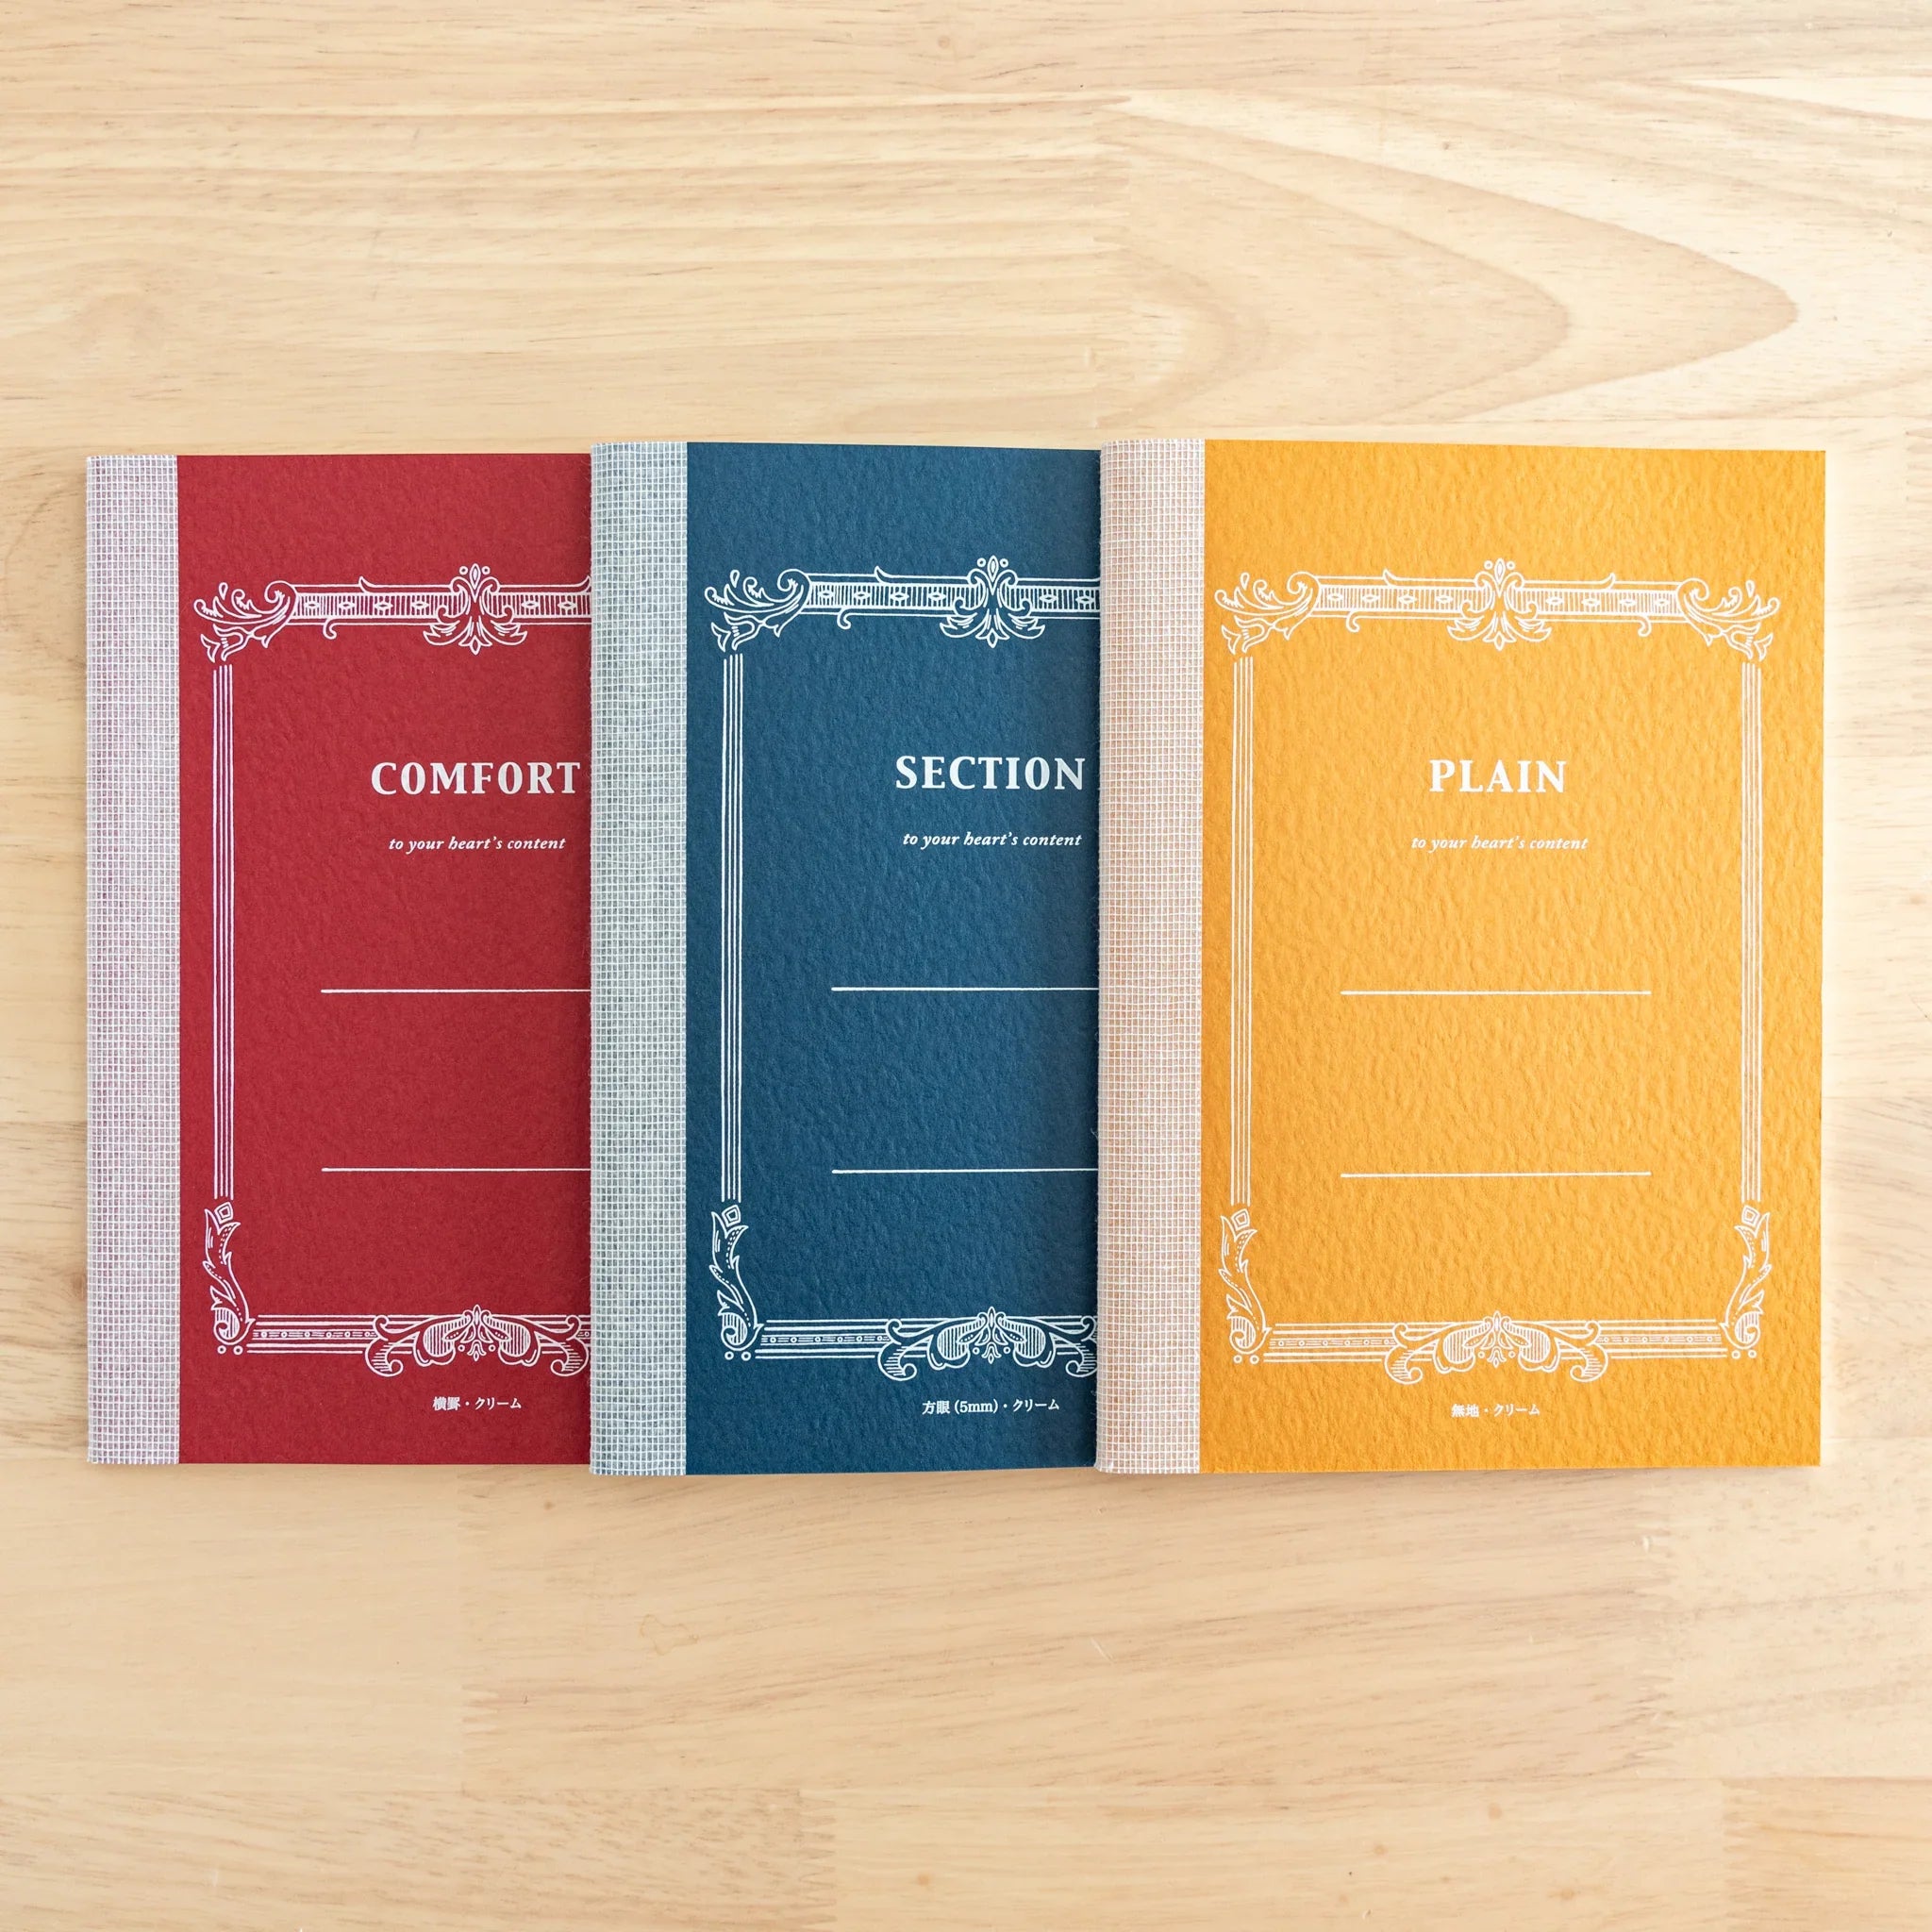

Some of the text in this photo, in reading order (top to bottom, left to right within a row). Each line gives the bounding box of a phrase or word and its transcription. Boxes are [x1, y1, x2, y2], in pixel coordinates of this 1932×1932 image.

[371, 761, 581, 795] COMFORT
[895, 755, 1086, 791] SECTION
[1429, 758, 1567, 793] PLAIN
[389, 836, 566, 855] to your heart’s content
[903, 831, 1083, 851] to your heart’s content
[1410, 834, 1589, 854] to your heart’s content
[1451, 1403, 1541, 1418] 無地・クリーム
